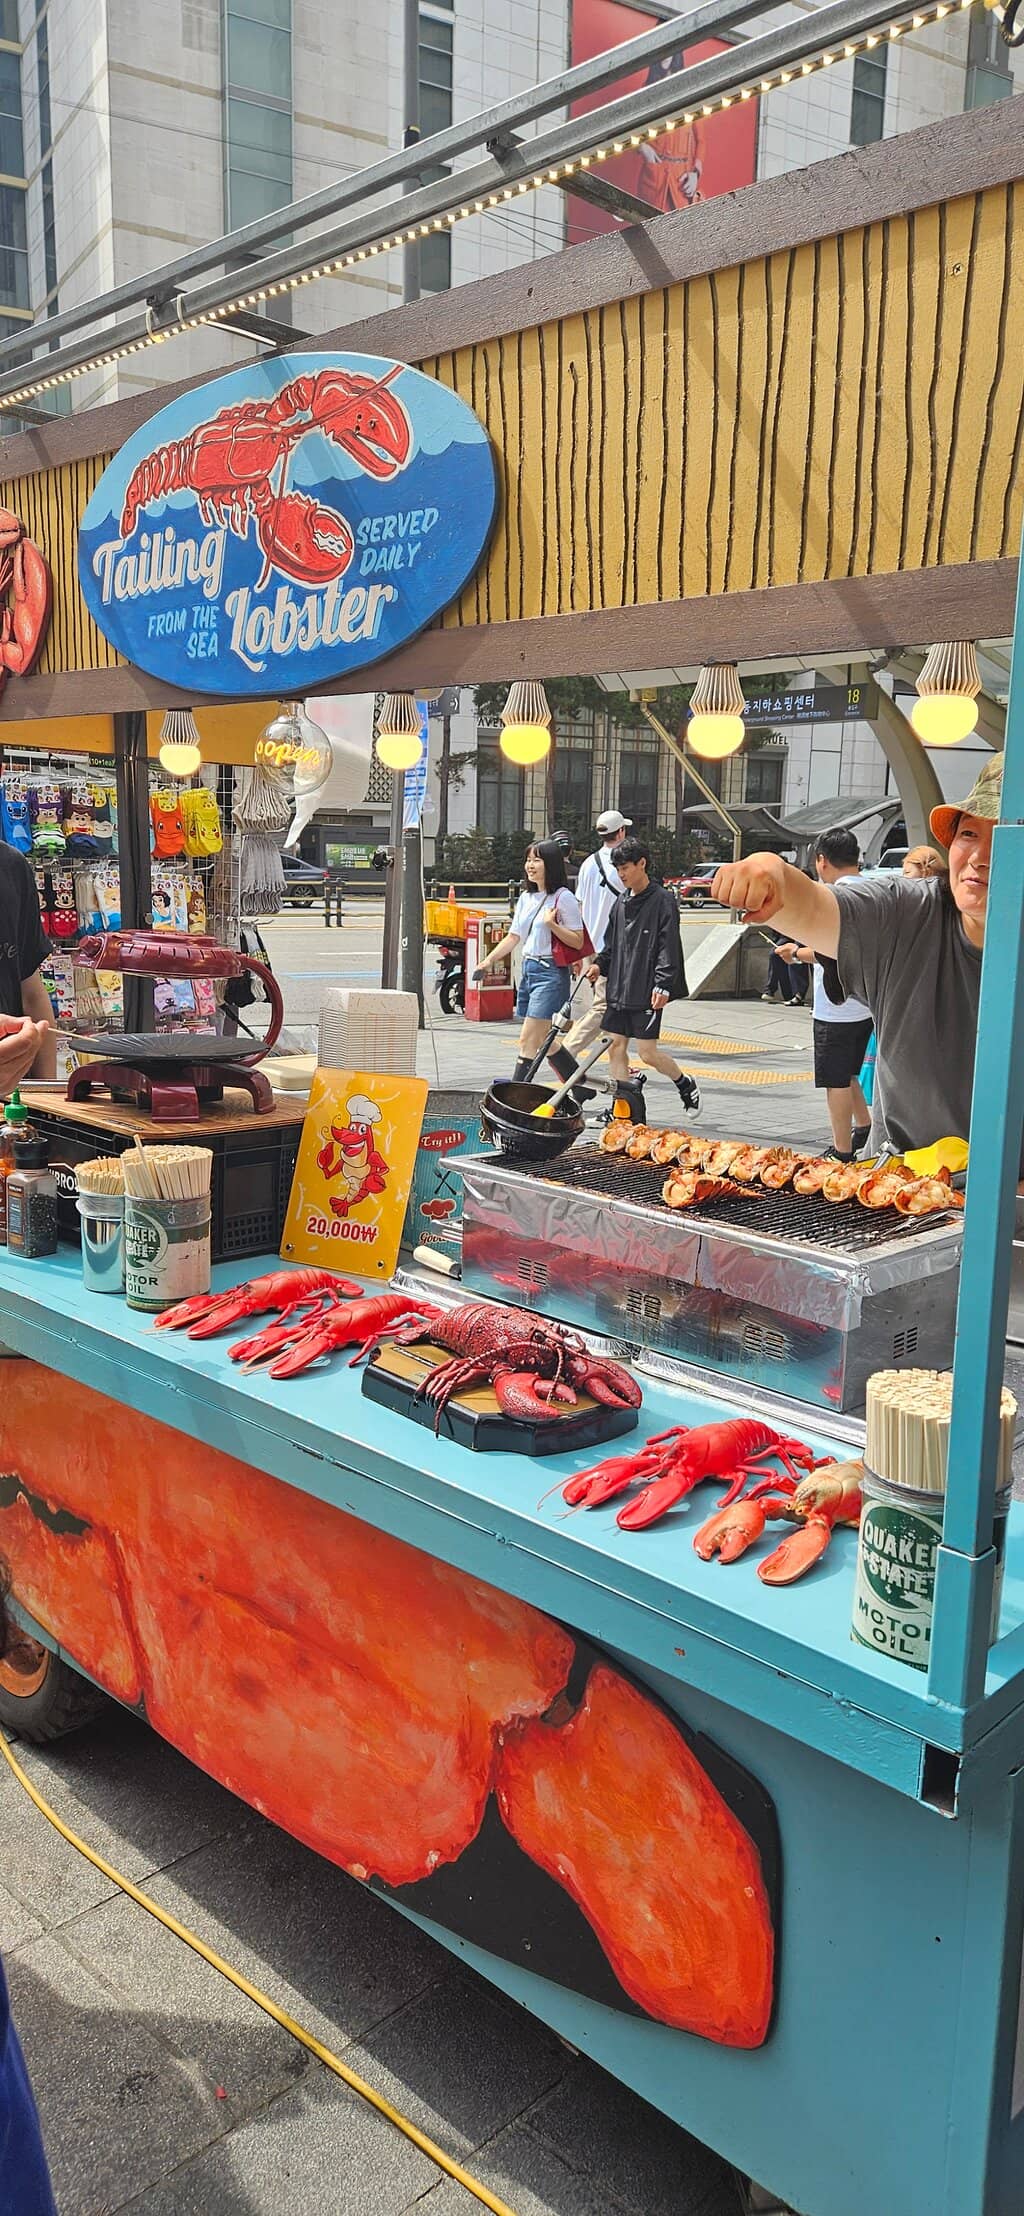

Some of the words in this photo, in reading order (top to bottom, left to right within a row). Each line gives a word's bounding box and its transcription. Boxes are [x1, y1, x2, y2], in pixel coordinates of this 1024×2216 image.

[357, 507, 439, 546] SERVED
[92, 526, 228, 606] Tailing
[359, 542, 422, 576] DAILY
[148, 607, 186, 638] FROM
[192, 605, 220, 629] THE
[224, 581, 398, 672] Lobster
[186, 631, 219, 659] SEA
[847, 688, 860, 704] 18
[421, 1136, 442, 1147] Try
[128, 1283, 145, 1295] OIL
[869, 1554, 928, 1594] STATE
[872, 1627, 914, 1655] OIL
